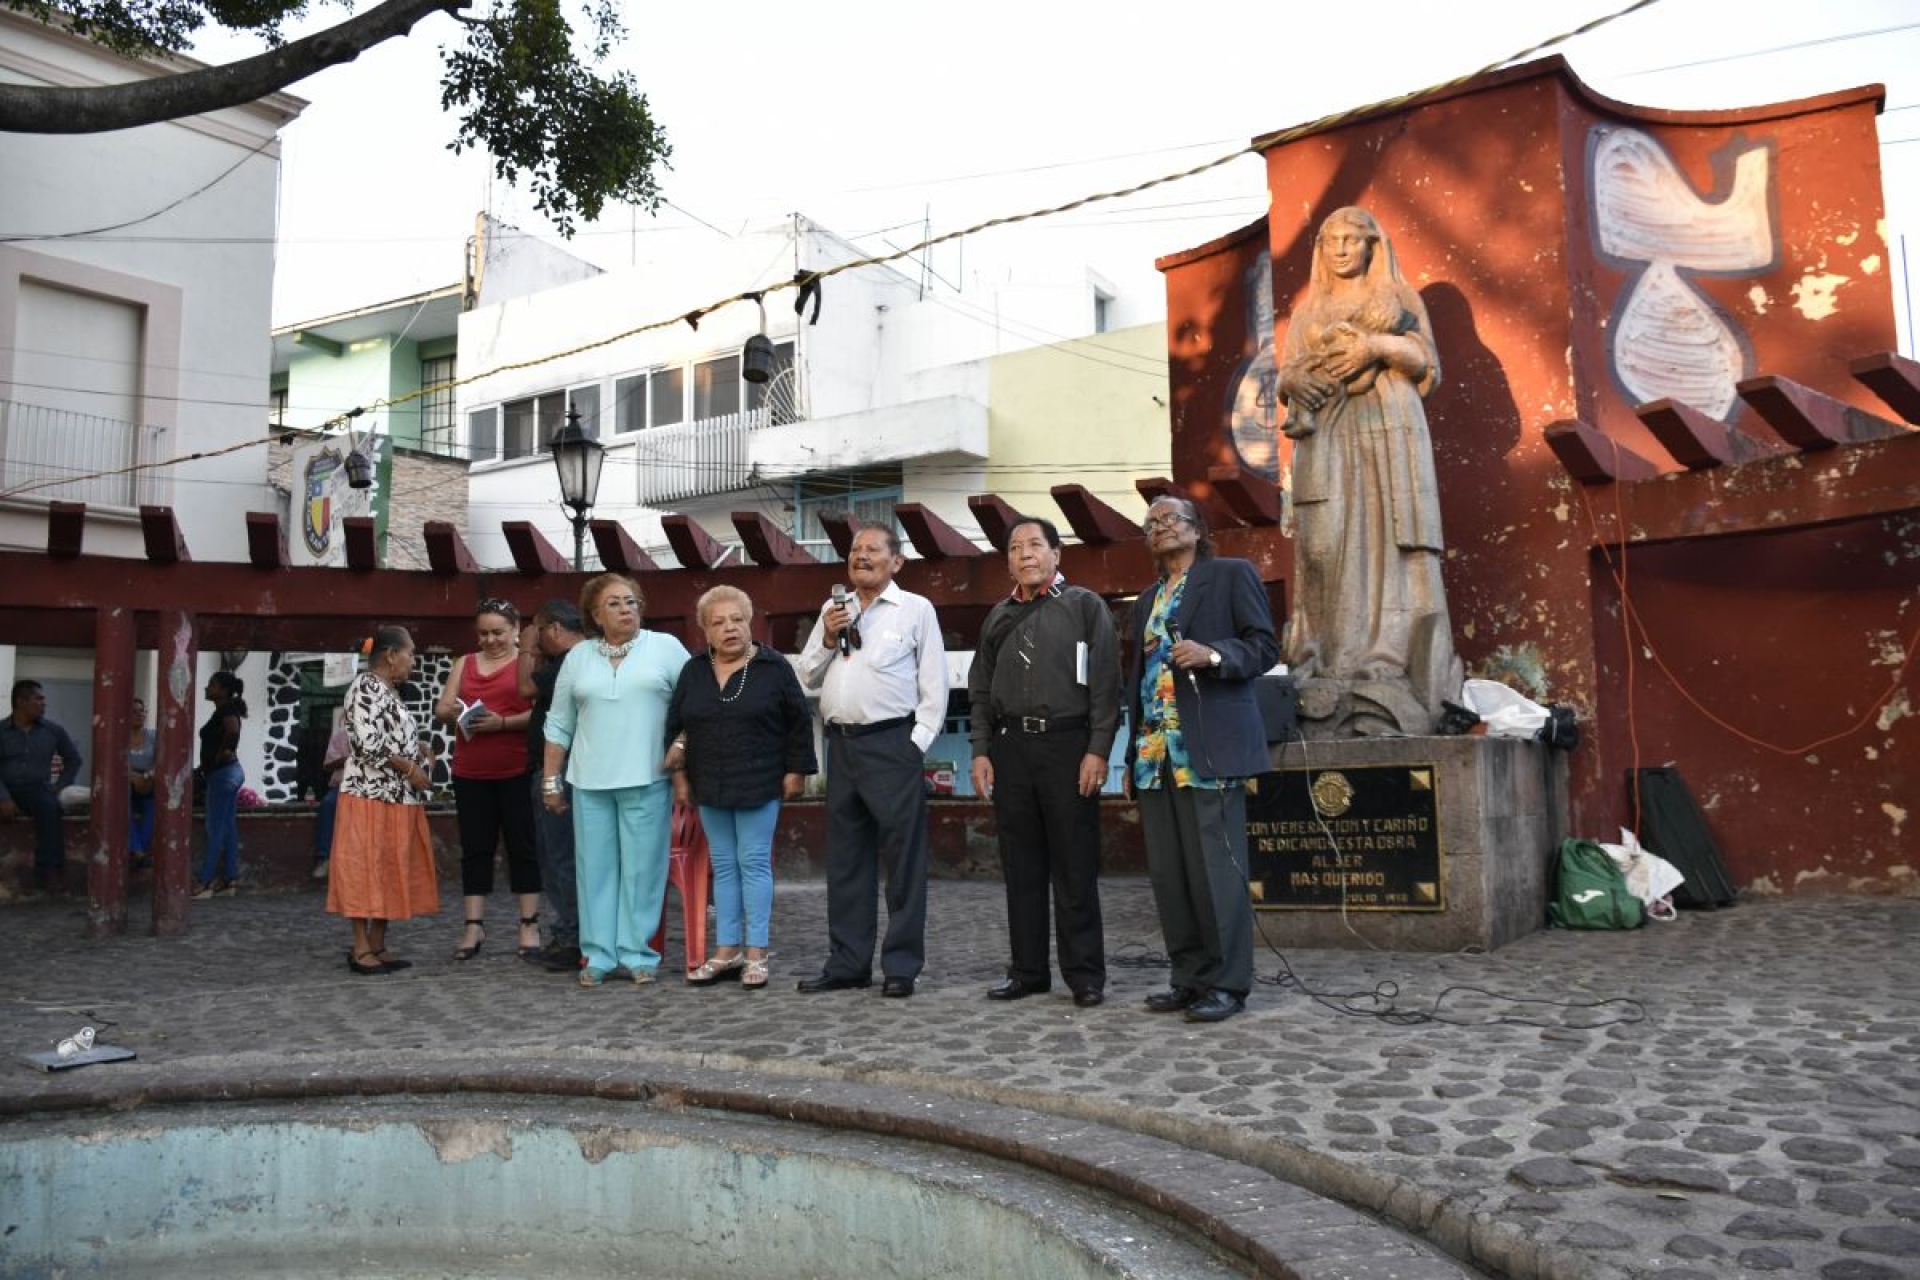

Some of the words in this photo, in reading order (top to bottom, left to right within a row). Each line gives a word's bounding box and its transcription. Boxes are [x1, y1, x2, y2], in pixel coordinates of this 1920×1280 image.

[1363, 818, 1370, 832] Y
[1374, 814, 1428, 832] CARIÑO
[1338, 836, 1374, 850] ESTA
[1376, 834, 1417, 849] OBRA
[1312, 855, 1331, 868] AL
[1335, 855, 1363, 868] SER
[1322, 871, 1384, 886] QUERIDO
